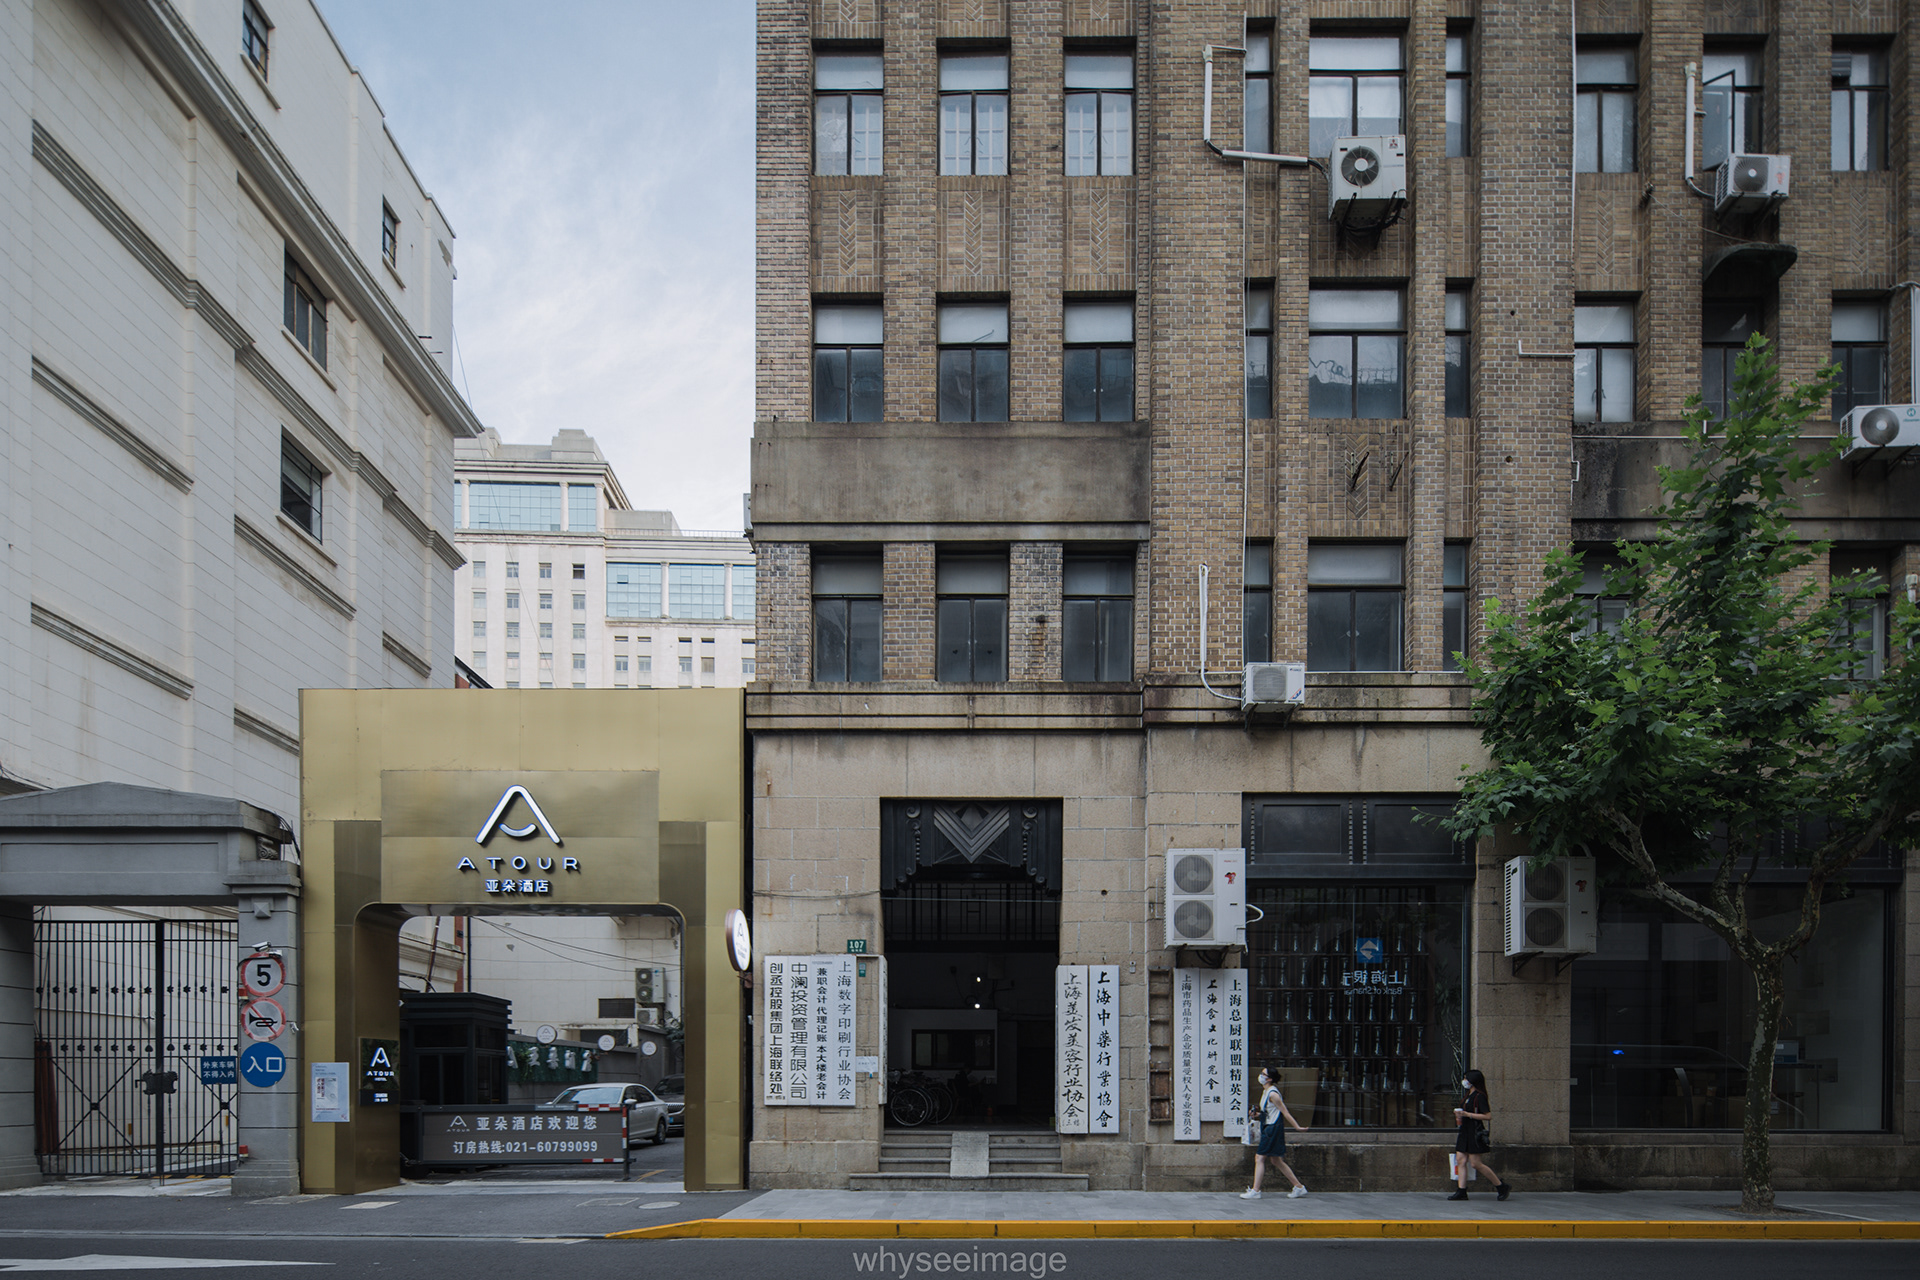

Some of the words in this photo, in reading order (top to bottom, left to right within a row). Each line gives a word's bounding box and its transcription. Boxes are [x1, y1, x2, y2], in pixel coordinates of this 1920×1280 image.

[457, 856, 579, 870] ATOUR
[485, 879, 549, 893] 亚朵酒店
[849, 941, 865, 949] 107
[257, 964, 271, 986] 5
[816, 967, 828, 1004] 兼职会计
[769, 962, 783, 1094] 创丞控股集团上海联络处
[790, 961, 808, 1100] 中澜投资管理有限公司
[816, 1006, 828, 1043] 代理记账
[837, 961, 852, 1101] 上海数字印刷行业协会
[1181, 974, 1193, 1135] 上海市药品生产企业质量受权人专业委员会
[1229, 979, 1242, 1111] 上海总厨联盟精英会
[203, 1061, 235, 1069] 外来车辆
[203, 1070, 235, 1078] 不得入内
[247, 1056, 282, 1073] 入口
[816, 1045, 828, 1100] 本大楼老会计
[1203, 1095, 1221, 1104] 三楼
[476, 1115, 598, 1130] 亚朵酒店欢迎您
[1228, 1117, 1245, 1125] 三楼
